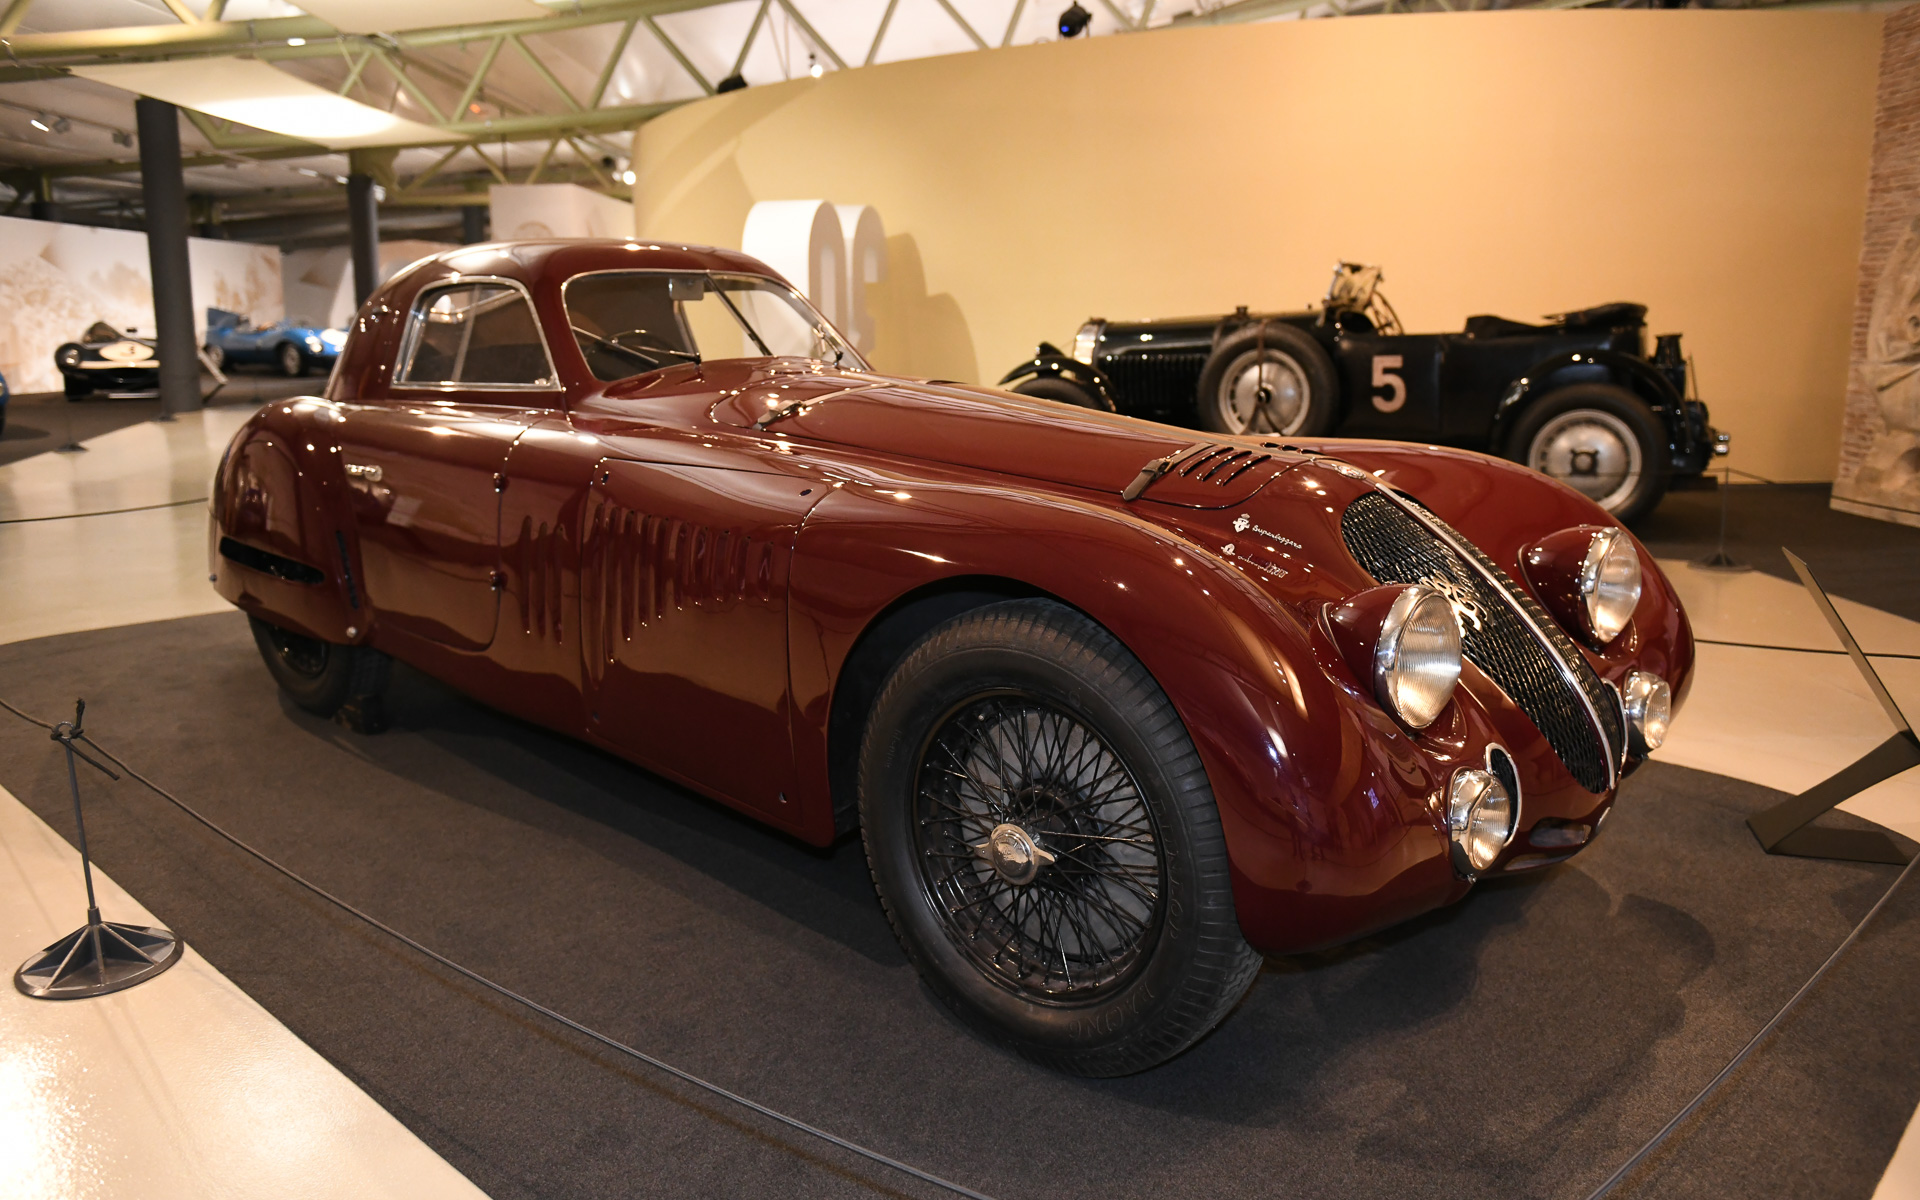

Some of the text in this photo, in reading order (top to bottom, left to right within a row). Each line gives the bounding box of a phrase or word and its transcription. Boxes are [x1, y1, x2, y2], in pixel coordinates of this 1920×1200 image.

[1371, 354, 1407, 414] 5
[1251, 524, 1303, 550] Superleggera
[1150, 798, 1184, 940] DUNLOP
[1067, 980, 1156, 1041] RACING
